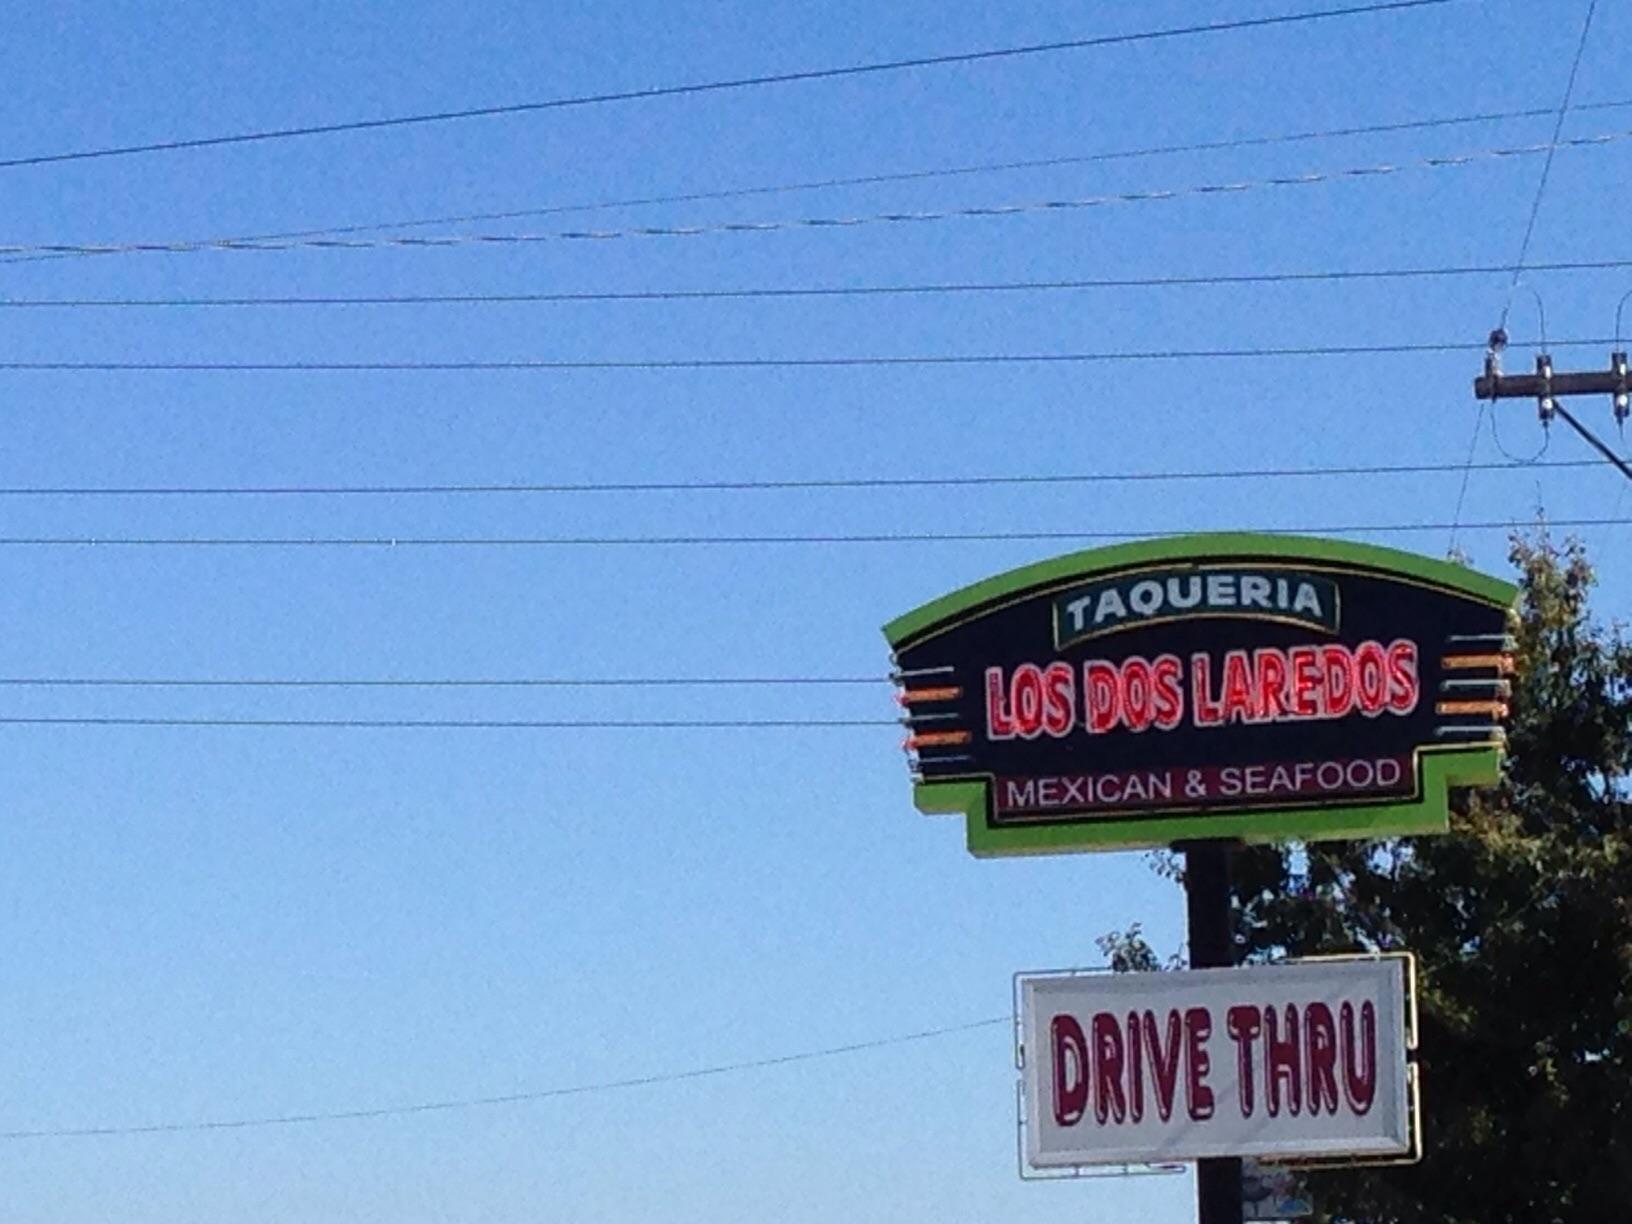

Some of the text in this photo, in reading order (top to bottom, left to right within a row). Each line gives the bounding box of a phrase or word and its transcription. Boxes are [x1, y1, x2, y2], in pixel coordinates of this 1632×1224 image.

[1067, 573, 1323, 631] TAQUERIA
[985, 640, 1419, 740] LOS DOS LAREDOS
[1006, 757, 1400, 808] MEXICAN & SEAFOOD
[1051, 1000, 1377, 1126] DRIVE THRU
